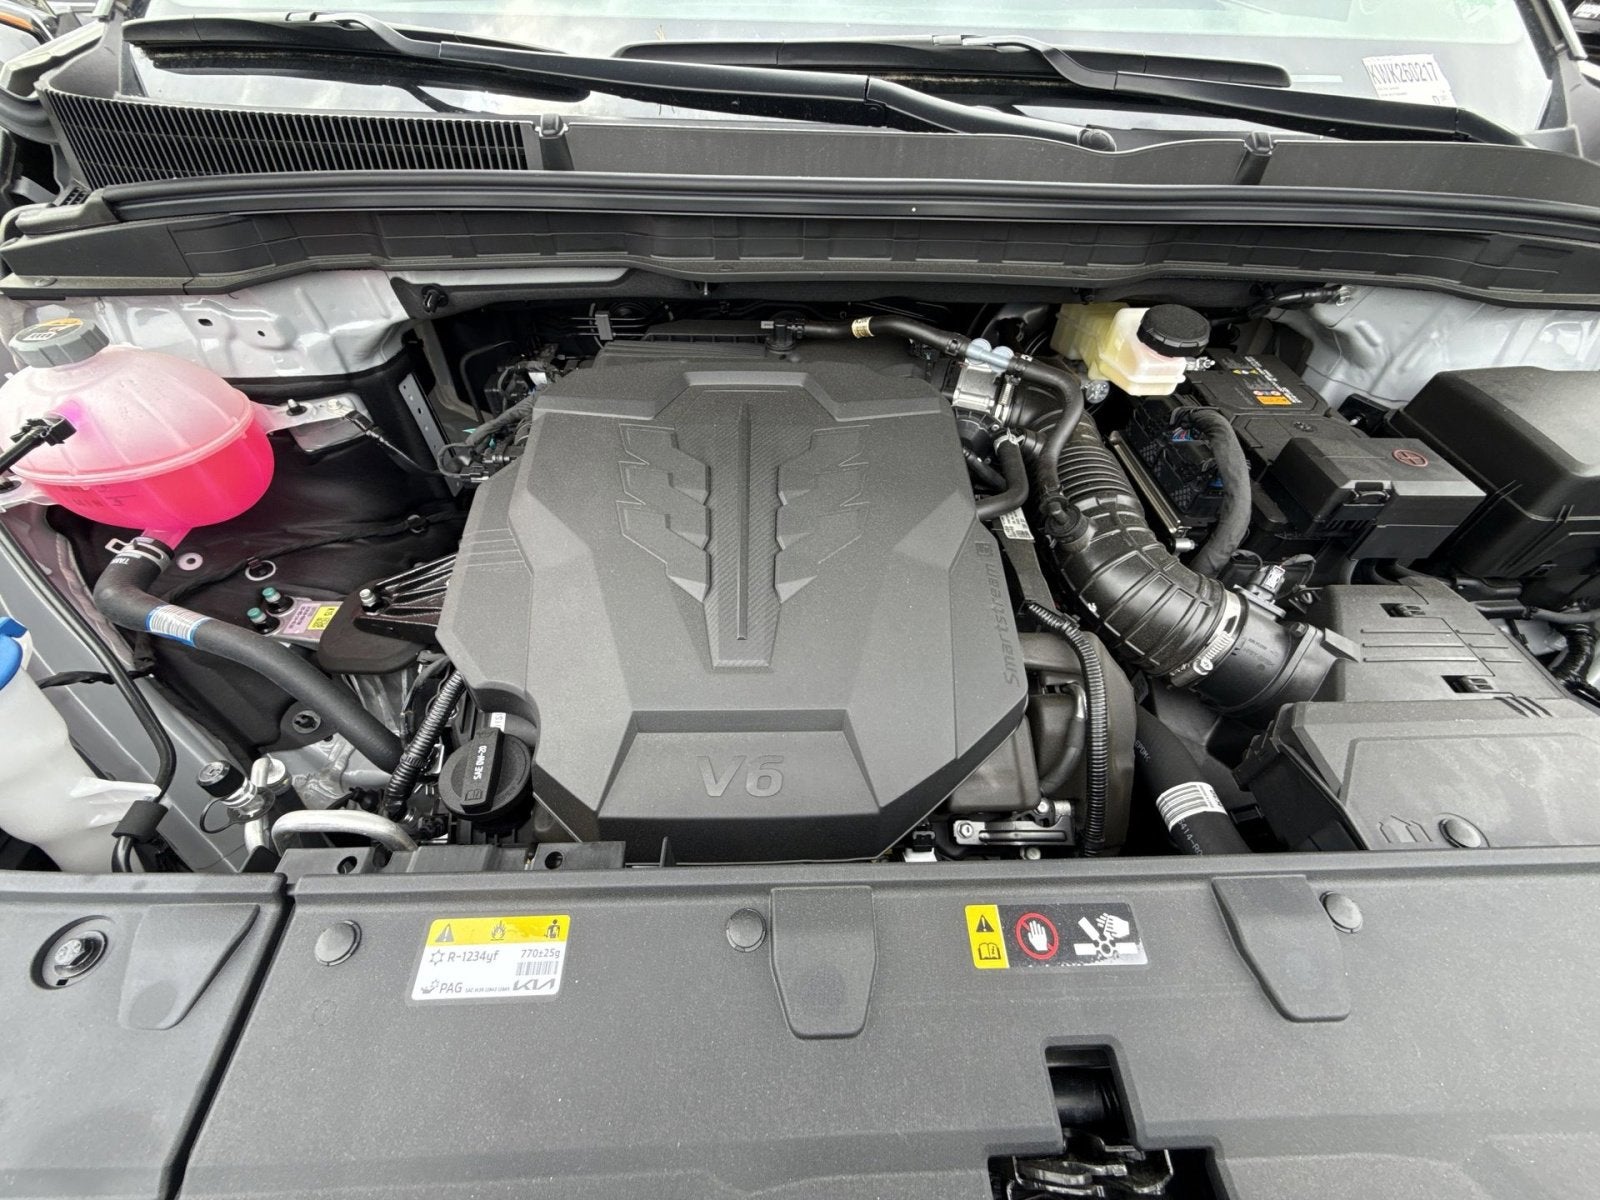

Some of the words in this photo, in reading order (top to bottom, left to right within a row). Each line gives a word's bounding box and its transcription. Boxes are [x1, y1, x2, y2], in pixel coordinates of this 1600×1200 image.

[1366, 62, 1439, 84] KWK260217
[985, 563, 1021, 688] Smartstream
[696, 754, 784, 797] V6
[447, 949, 499, 963] R-1234yf
[521, 949, 561, 959] 770±25g
[439, 982, 463, 994] PAG
[513, 978, 556, 990] KIA
